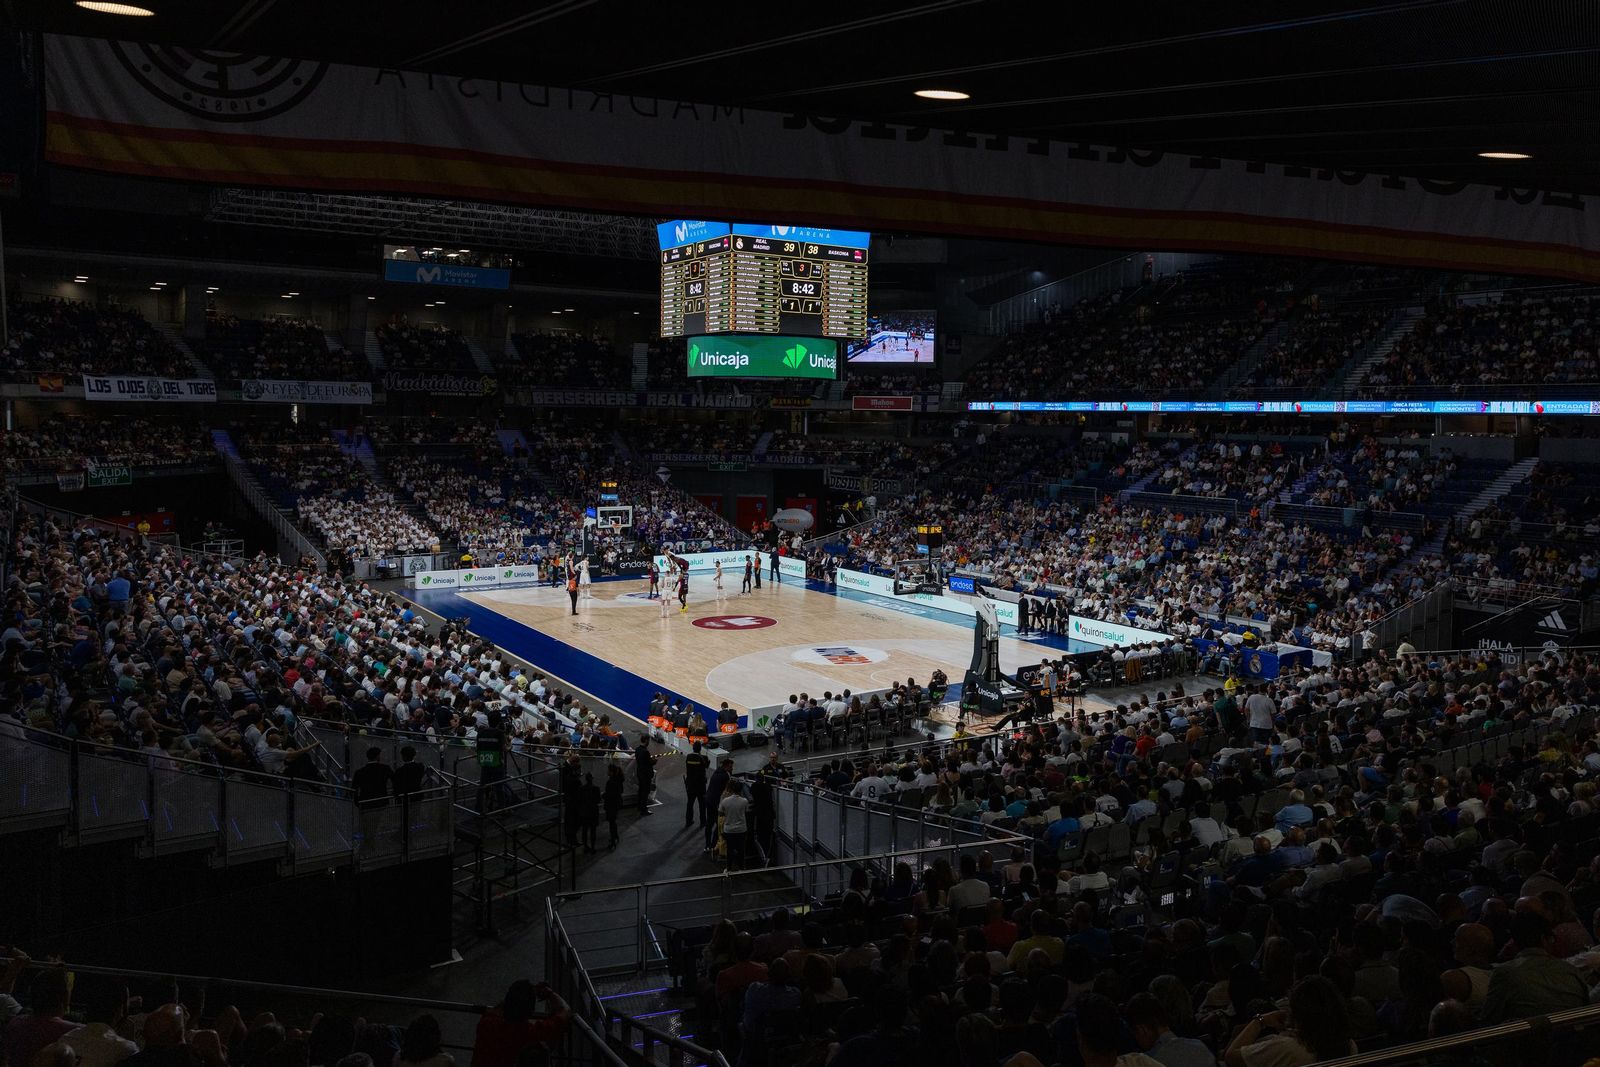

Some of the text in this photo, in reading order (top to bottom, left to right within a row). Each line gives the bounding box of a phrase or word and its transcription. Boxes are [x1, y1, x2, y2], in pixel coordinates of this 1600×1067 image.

[783, 242, 795, 252] 39
[807, 245, 819, 254] 38
[444, 270, 478, 278] Movistar
[800, 264, 805, 272] 3
[792, 282, 815, 294] 8:42
[808, 304, 812, 312] 1
[700, 352, 749, 369] Unicaja
[809, 354, 837, 372] Unicaj
[88, 378, 216, 395] LOS OJOS DEL TIGRE
[262, 383, 301, 394] REYES
[307, 384, 323, 394] DE
[532, 391, 752, 407] BERSERKERS REAL MADRID
[91, 468, 129, 479] SALIDA
[831, 476, 860, 490] DESDE
[620, 560, 648, 568] endes
[432, 577, 455, 585] Unicaja
[950, 580, 974, 590] endesa
[1470, 650, 1519, 664] MARID!
[978, 688, 999, 700] Unicaja
[868, 785, 876, 798] 8
